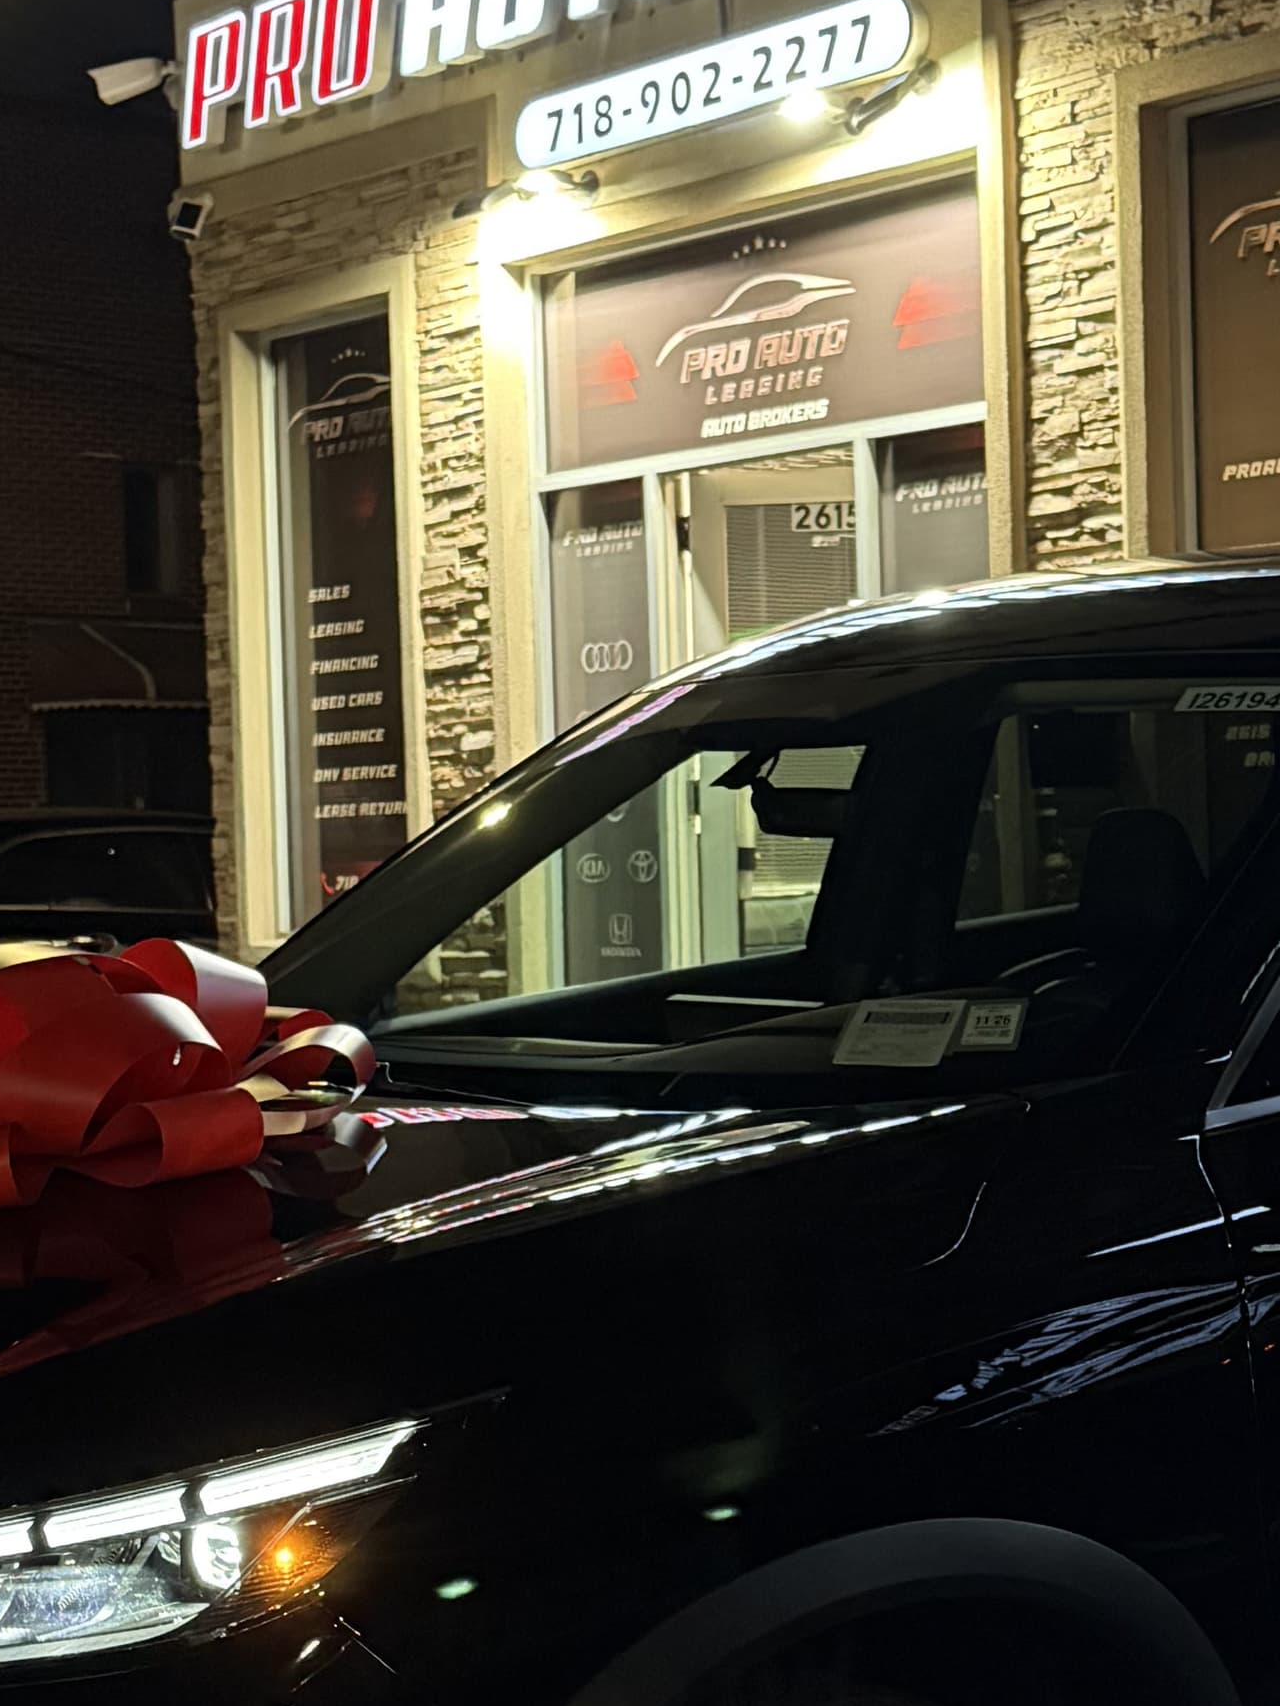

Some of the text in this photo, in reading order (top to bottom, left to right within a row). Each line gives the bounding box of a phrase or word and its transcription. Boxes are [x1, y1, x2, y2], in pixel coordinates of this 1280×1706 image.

[546, 13, 872, 153] 718-902-2277
[680, 318, 850, 384] PRO AUTO
[704, 364, 824, 405] LEASING
[348, 405, 391, 437] AUT
[701, 397, 830, 438] AUTO BROKERS
[940, 471, 987, 495] AUT
[308, 584, 351, 604] SALES
[308, 619, 365, 640] LEASING
[309, 654, 380, 676] FINANCING
[311, 690, 384, 712] USED CARS
[312, 728, 386, 748] INSURANCE
[312, 764, 398, 784] DMV SERVICE
[314, 803, 359, 820] LEASE
